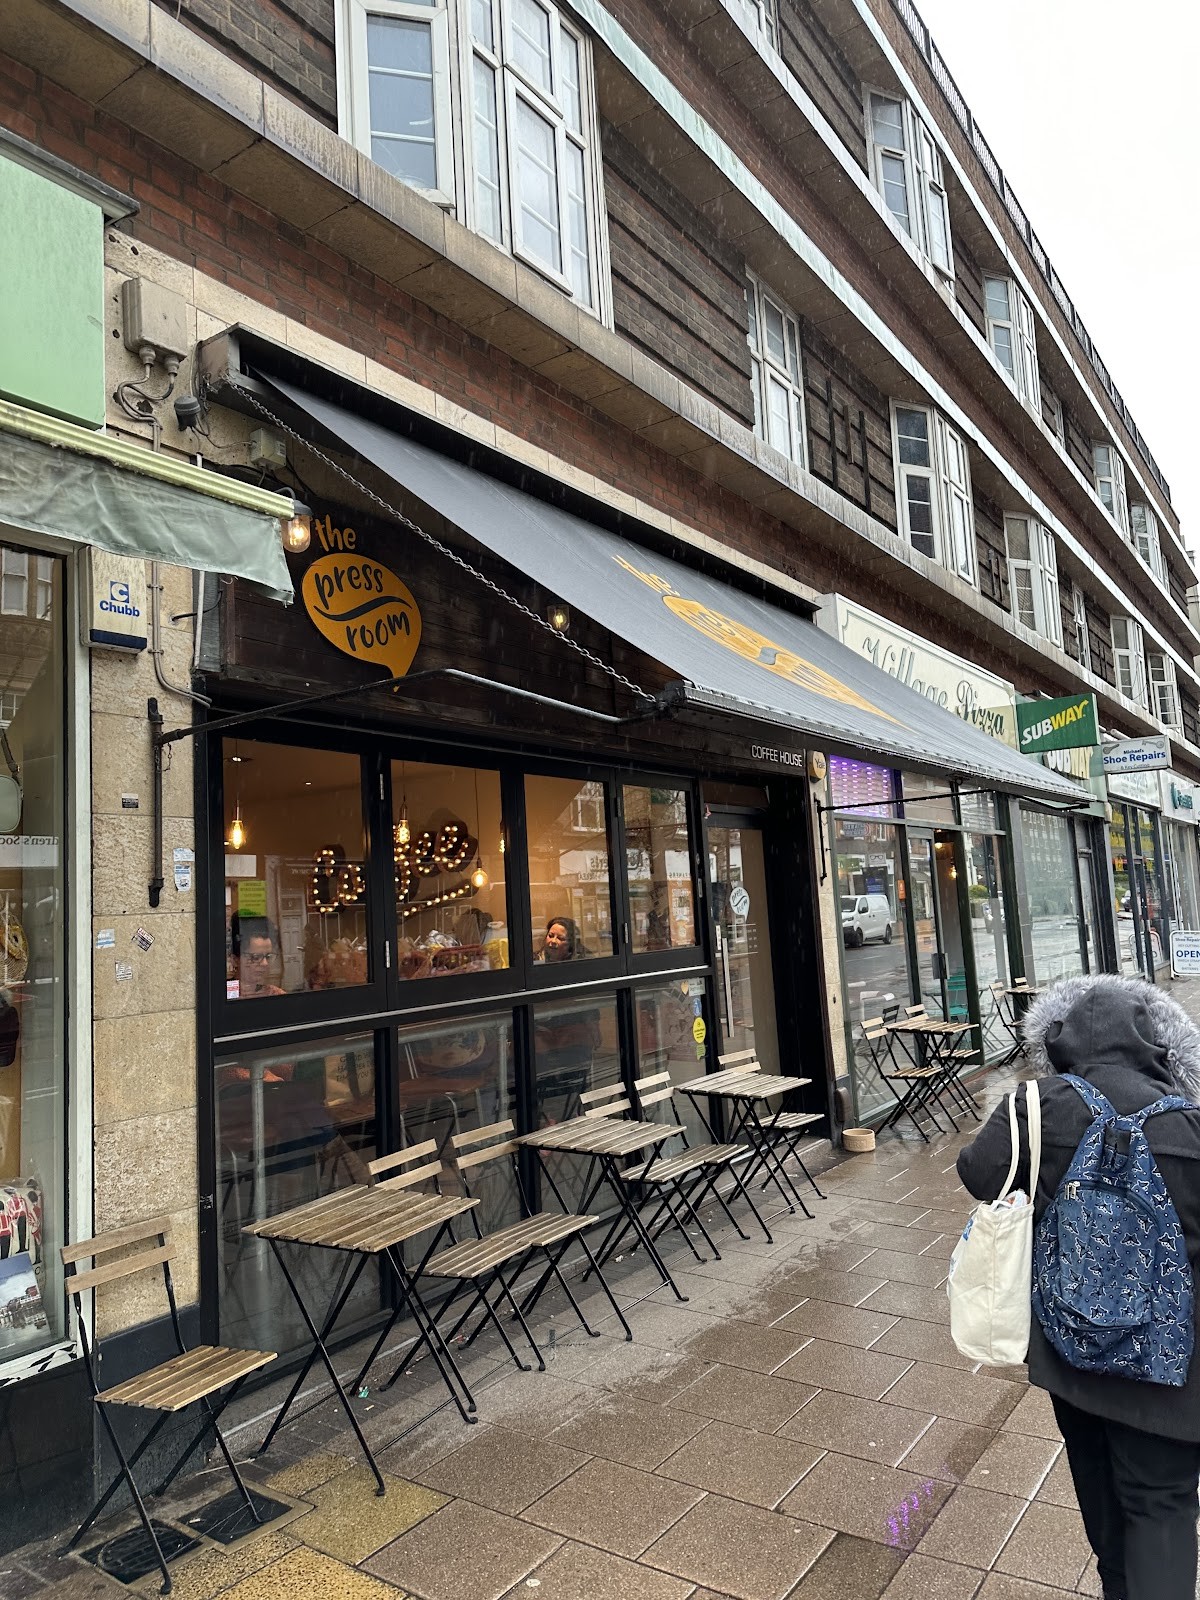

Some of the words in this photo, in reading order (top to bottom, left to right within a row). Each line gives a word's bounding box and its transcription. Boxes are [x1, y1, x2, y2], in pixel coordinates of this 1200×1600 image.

[315, 514, 356, 551] the
[315, 563, 384, 610] press
[99, 600, 140, 617] Chubb
[345, 611, 410, 651] room
[956, 679, 1006, 736] Pizza
[1020, 699, 1089, 745] SUBWAY
[751, 744, 779, 762] COFFEE
[779, 751, 803, 767] HOUSE
[1103, 755, 1127, 765] Shoe
[1129, 751, 1166, 762] Repairs
